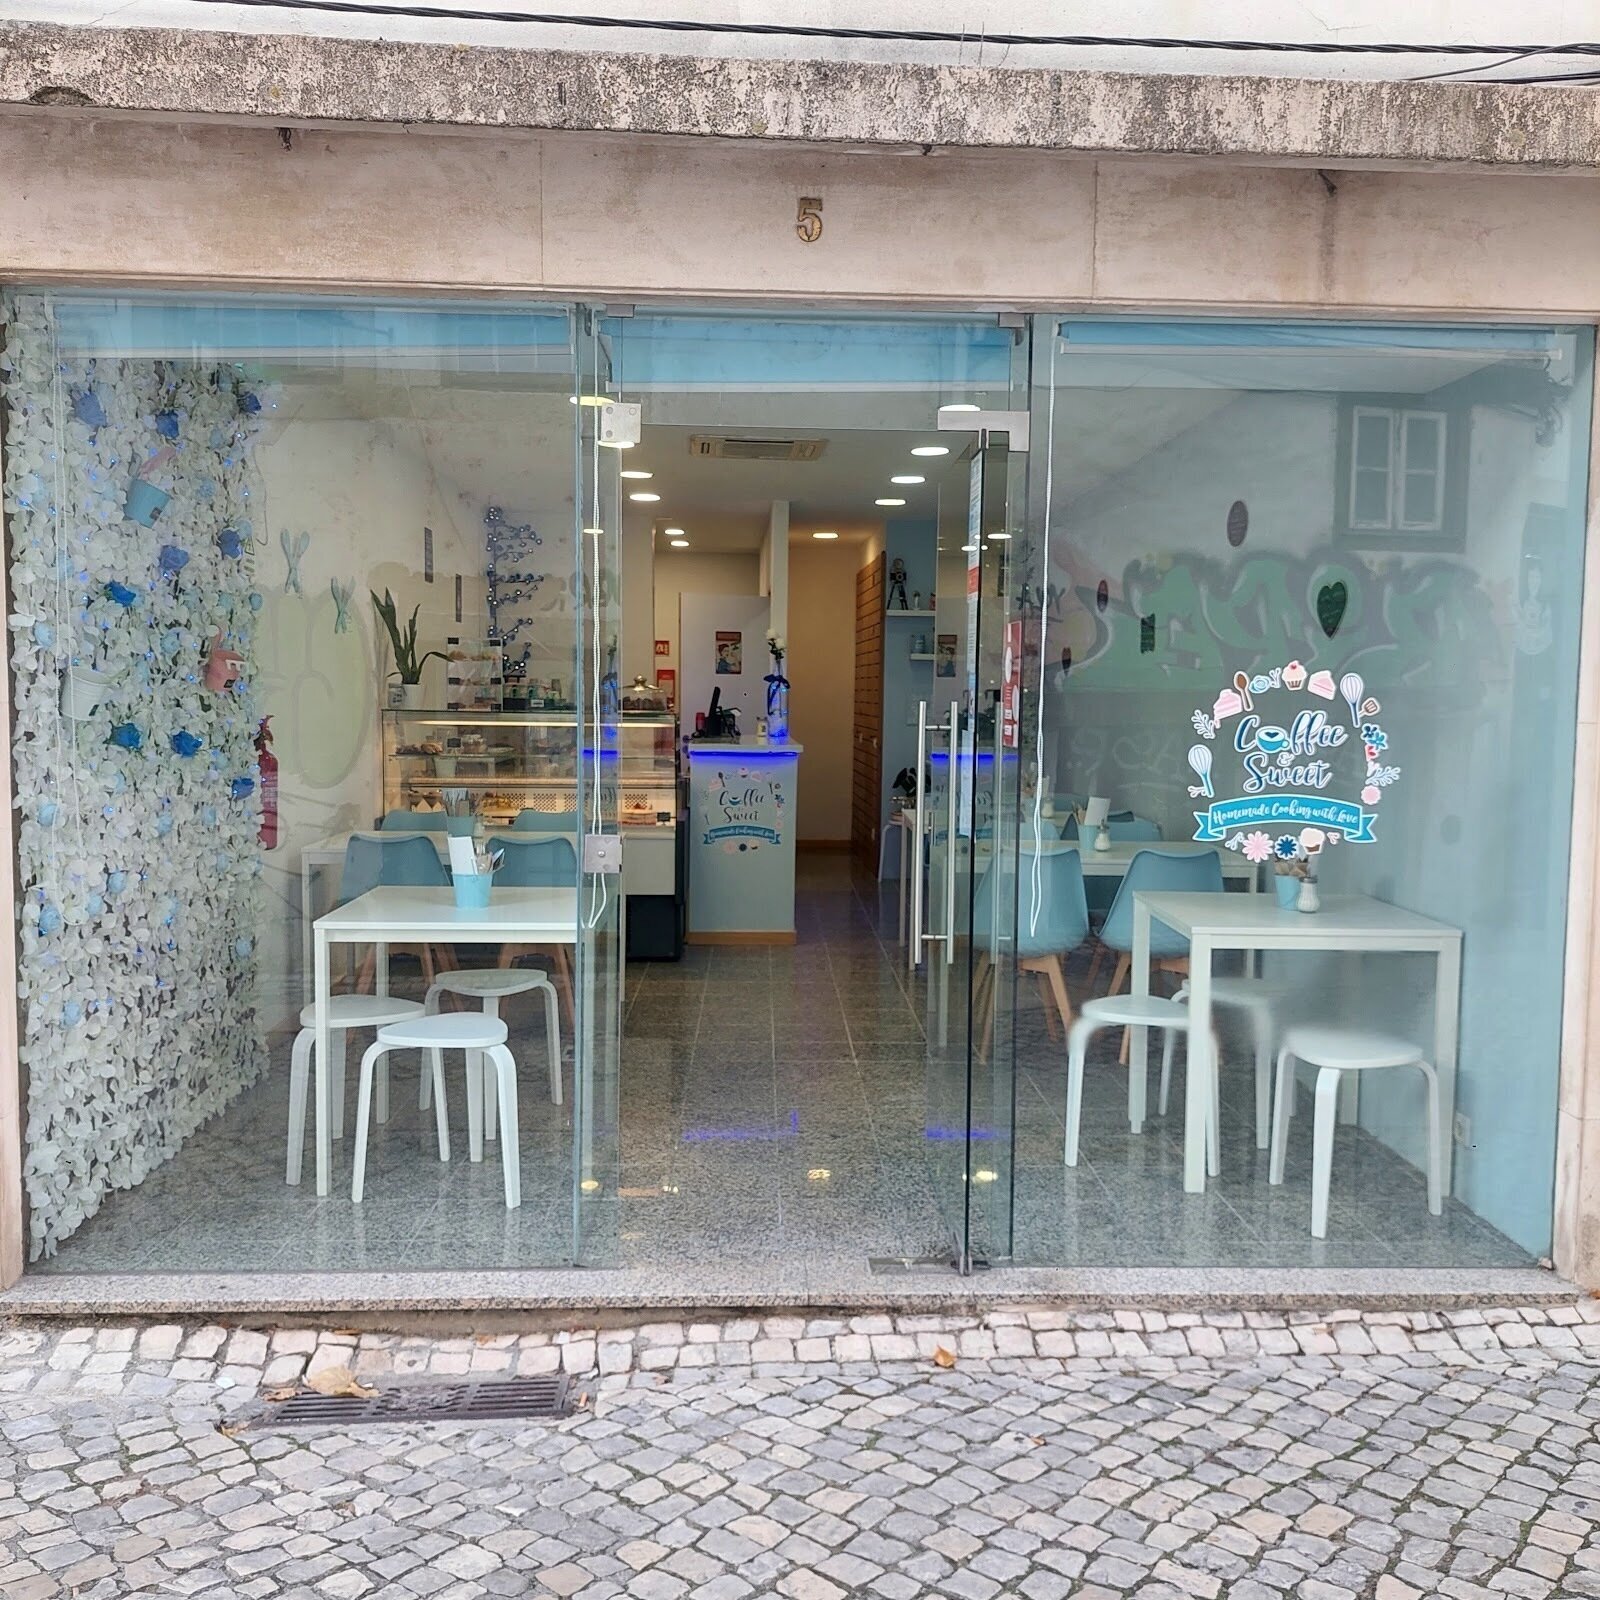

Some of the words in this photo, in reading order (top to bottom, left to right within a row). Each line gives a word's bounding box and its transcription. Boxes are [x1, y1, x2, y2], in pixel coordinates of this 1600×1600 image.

[797, 197, 823, 242] 5
[1234, 710, 1348, 756] Coffee
[1243, 751, 1333, 793] Sweet
[1277, 752, 1295, 767] &
[1212, 804, 1270, 825] Homemade
[1271, 799, 1312, 821] Cooking
[1312, 808, 1338, 821] with
[1336, 810, 1359, 824] Love
